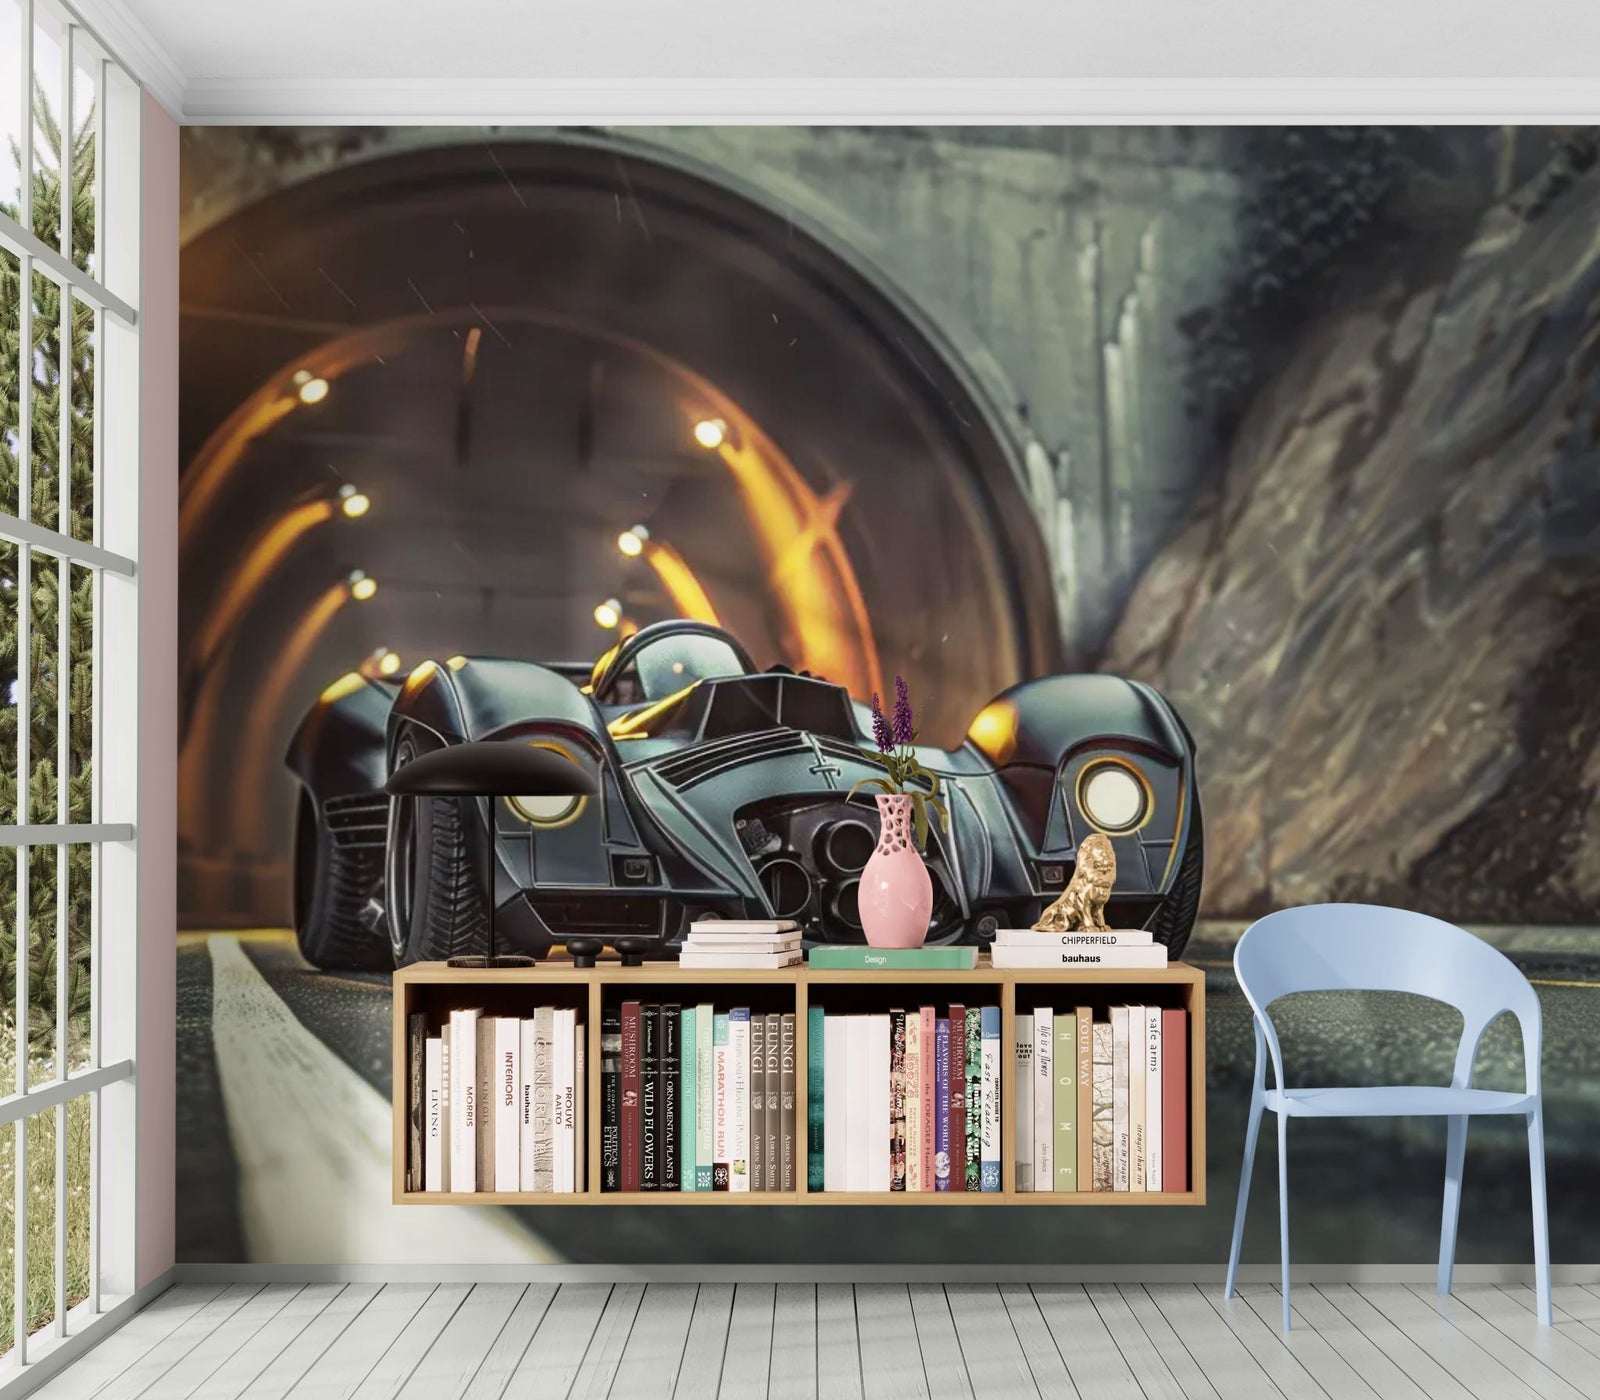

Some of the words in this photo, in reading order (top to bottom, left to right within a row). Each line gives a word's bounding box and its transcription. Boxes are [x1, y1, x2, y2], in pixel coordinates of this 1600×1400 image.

[1062, 936, 1117, 945] CHIPPERFIELD
[864, 955, 887, 966] Design
[1062, 954, 1101, 963] bauhaus
[1038, 1026, 1050, 1038] life
[1081, 1017, 1089, 1054] YOUR
[1150, 1018, 1161, 1040] safe
[752, 1022, 762, 1074] FUNGI
[767, 1022, 778, 1074] FUNGI
[783, 1022, 793, 1074] FUNGI
[1150, 1044, 1158, 1072] arms
[1037, 1054, 1050, 1077] flower
[1081, 1060, 1089, 1086] WAY
[942, 1079, 948, 1090] OF
[644, 1082, 654, 1116] WILD
[982, 1091, 992, 1148] Reading
[644, 1118, 654, 1179] FLOWERS
[966, 1136, 974, 1166] skills
